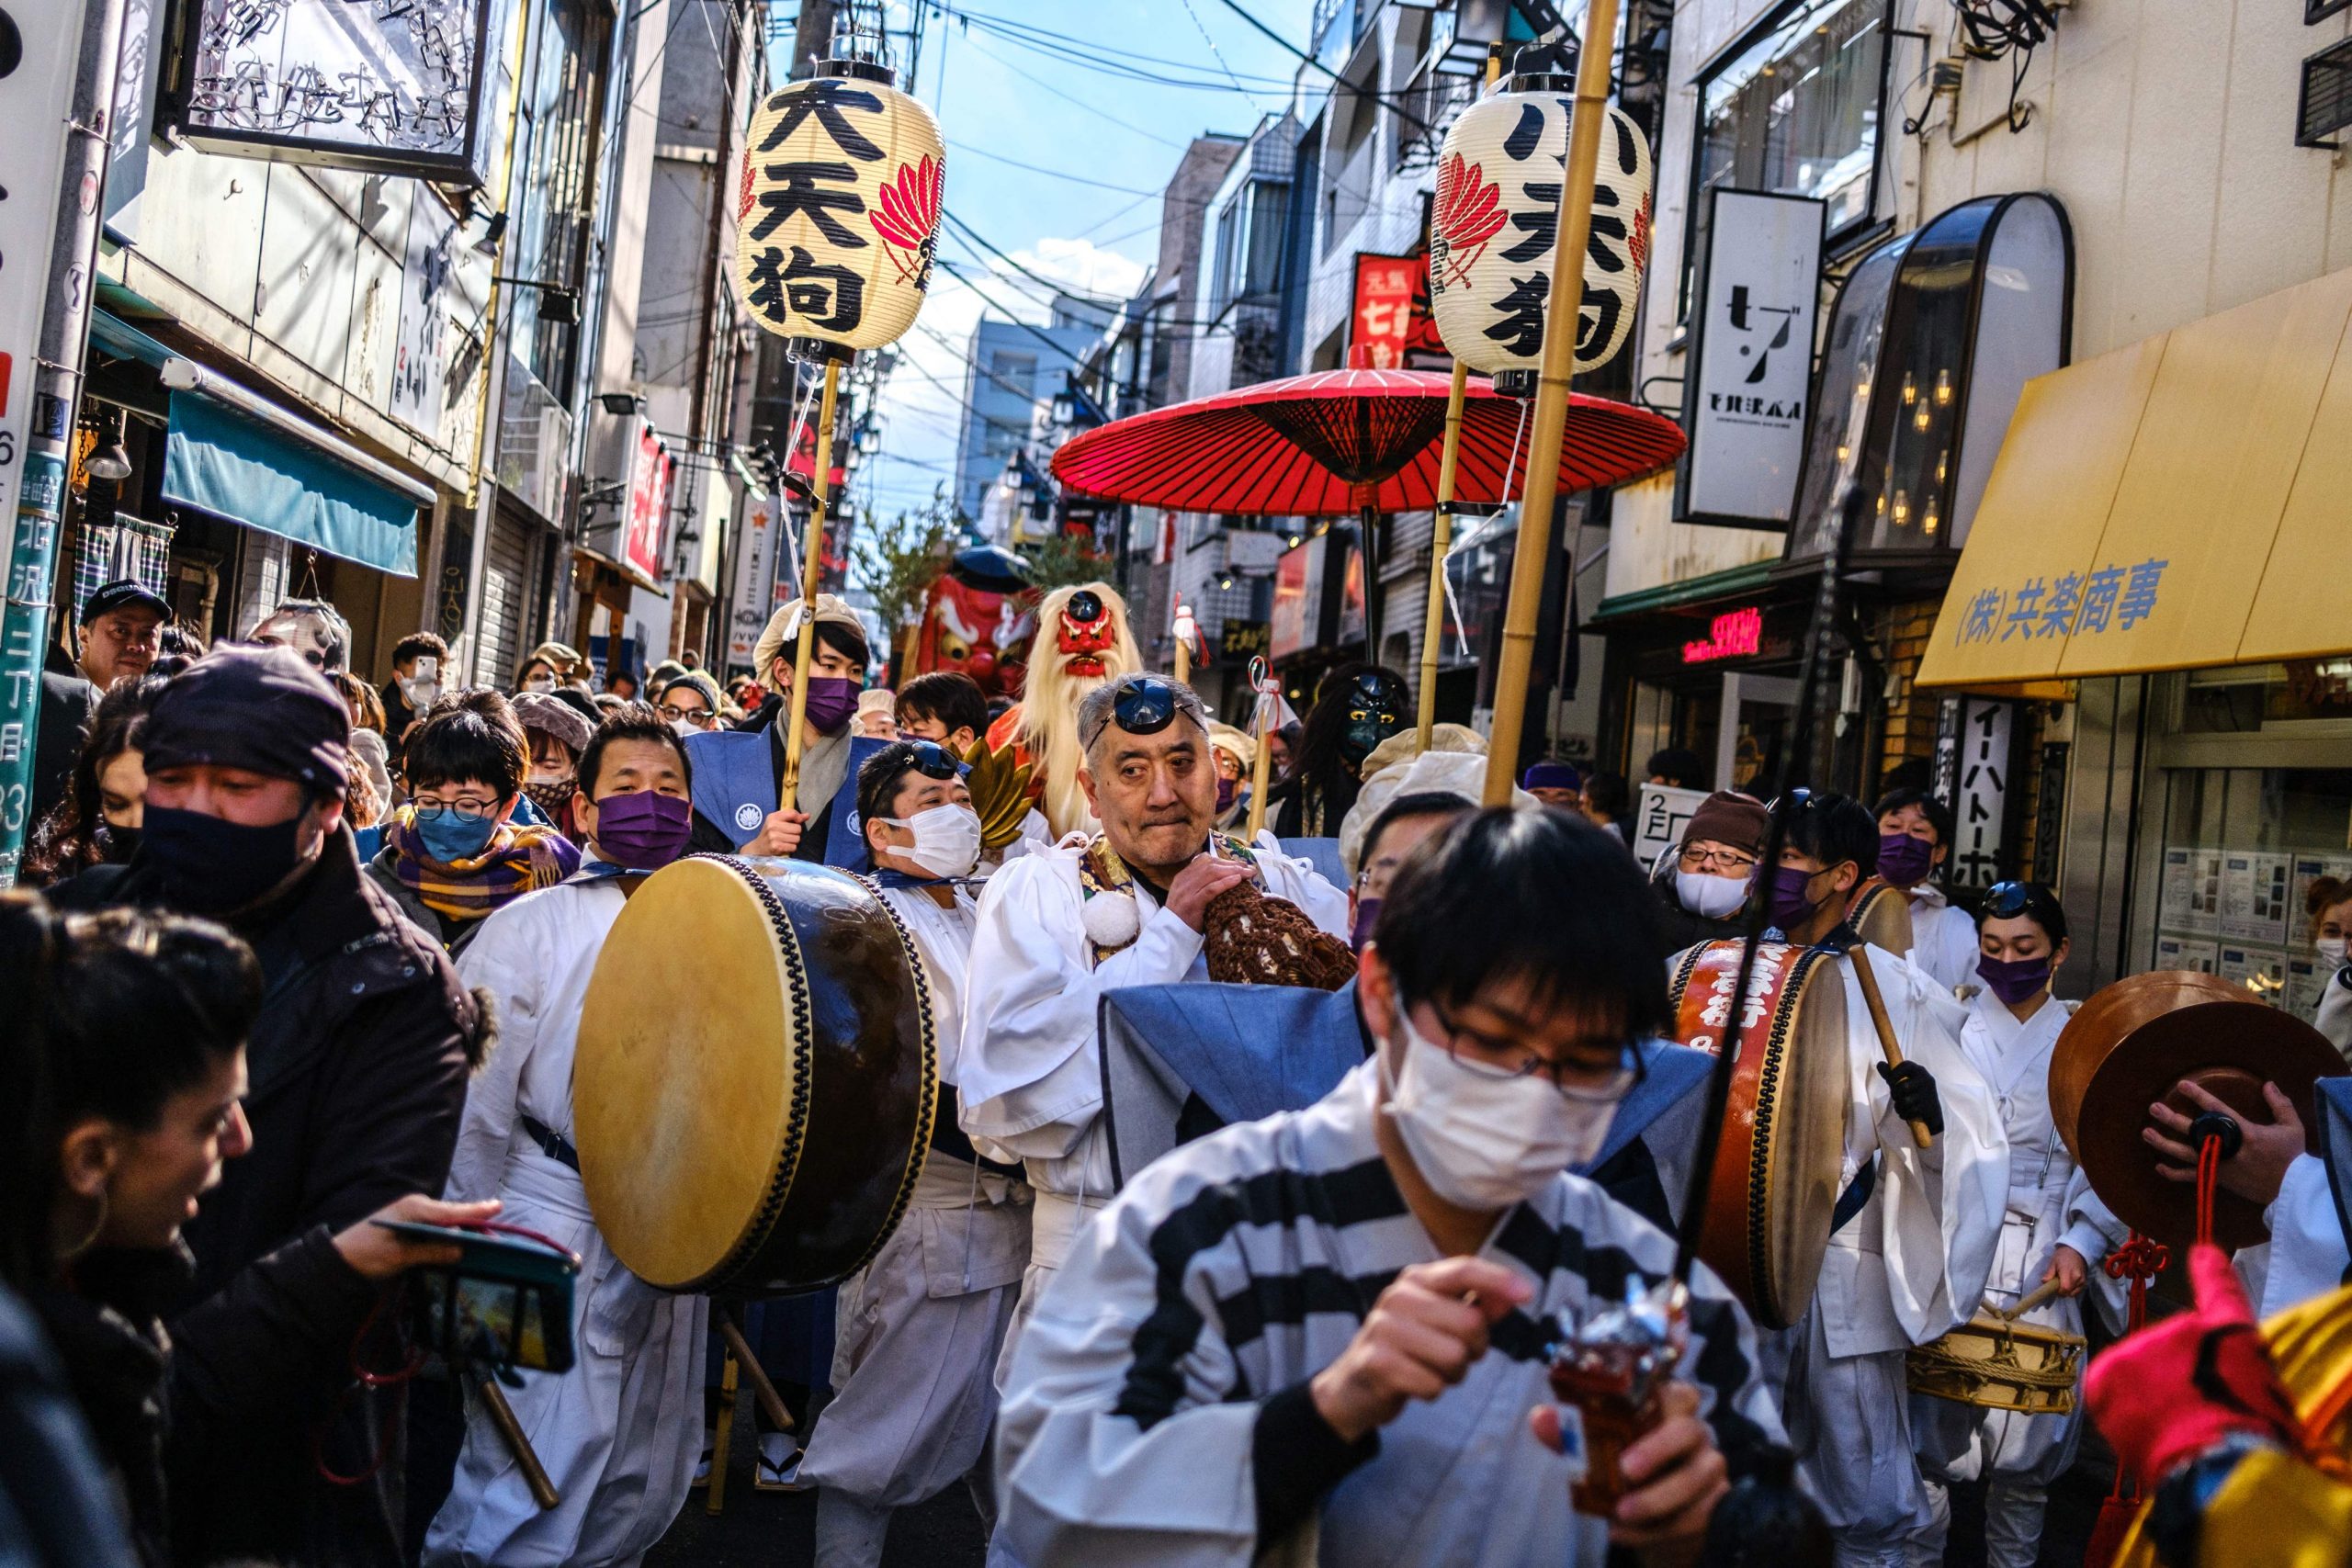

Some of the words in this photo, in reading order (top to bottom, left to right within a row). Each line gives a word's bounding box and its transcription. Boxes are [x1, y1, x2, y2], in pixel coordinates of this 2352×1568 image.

[747, 79, 887, 333] 大天狗
[1483, 98, 1637, 362] 小天狗
[1954, 557, 2169, 648] (株)共楽商事
[1953, 704, 2004, 886] イーハトーボ
